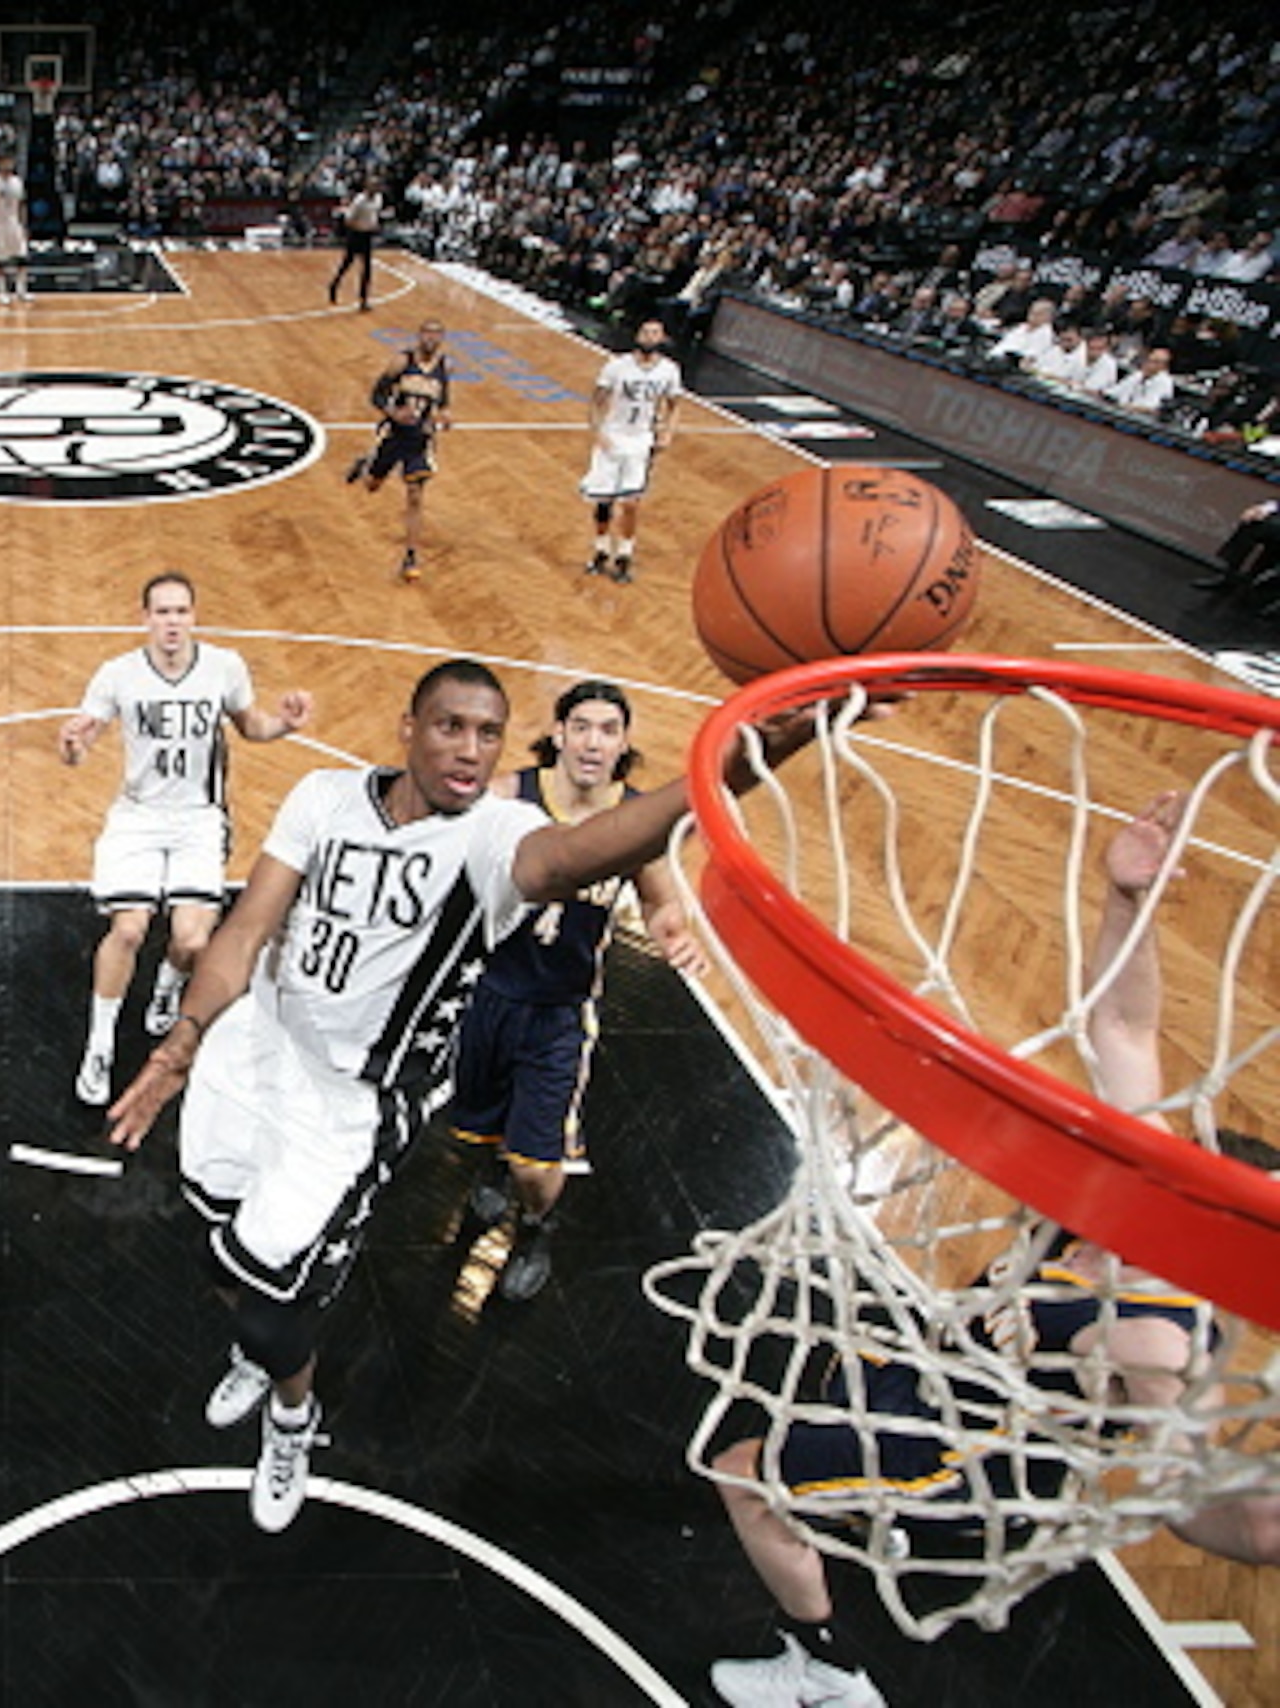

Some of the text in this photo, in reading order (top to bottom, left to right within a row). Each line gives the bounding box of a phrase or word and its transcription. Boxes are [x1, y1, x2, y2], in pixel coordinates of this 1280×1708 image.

[925, 386, 1110, 483] TOSHIBA
[137, 699, 212, 740] NETS
[156, 747, 186, 779] 44
[307, 838, 431, 928] NETS
[533, 901, 564, 946] 4
[301, 917, 359, 993] 30
